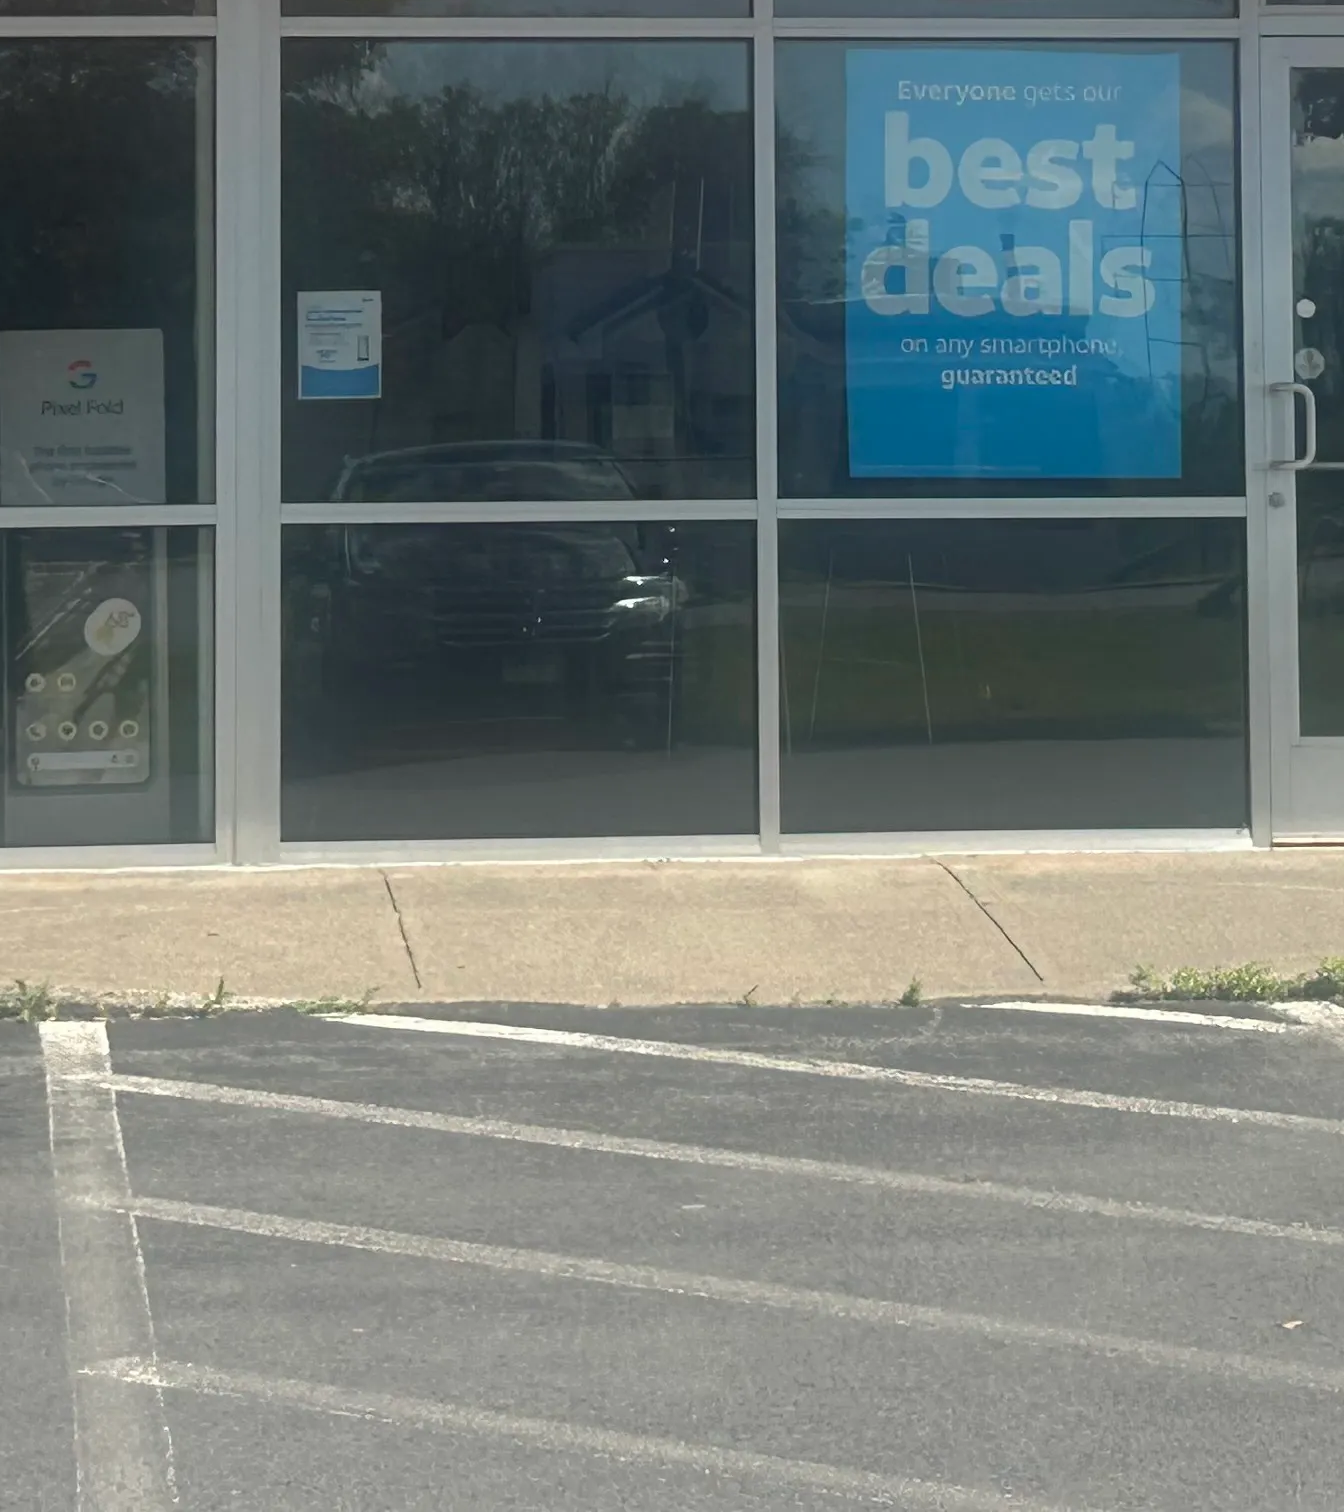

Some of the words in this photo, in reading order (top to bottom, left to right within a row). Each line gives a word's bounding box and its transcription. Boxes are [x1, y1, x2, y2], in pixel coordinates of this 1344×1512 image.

[898, 80, 1017, 105] Everyone
[1024, 83, 1076, 106] gets
[1083, 86, 1122, 102] our
[884, 111, 1137, 209] best
[861, 219, 1157, 317] deals
[900, 337, 929, 353] on
[935, 338, 974, 357] any
[941, 365, 1078, 390] guaranteed
[41, 400, 82, 416] Pixel
[86, 399, 124, 414] Fold
